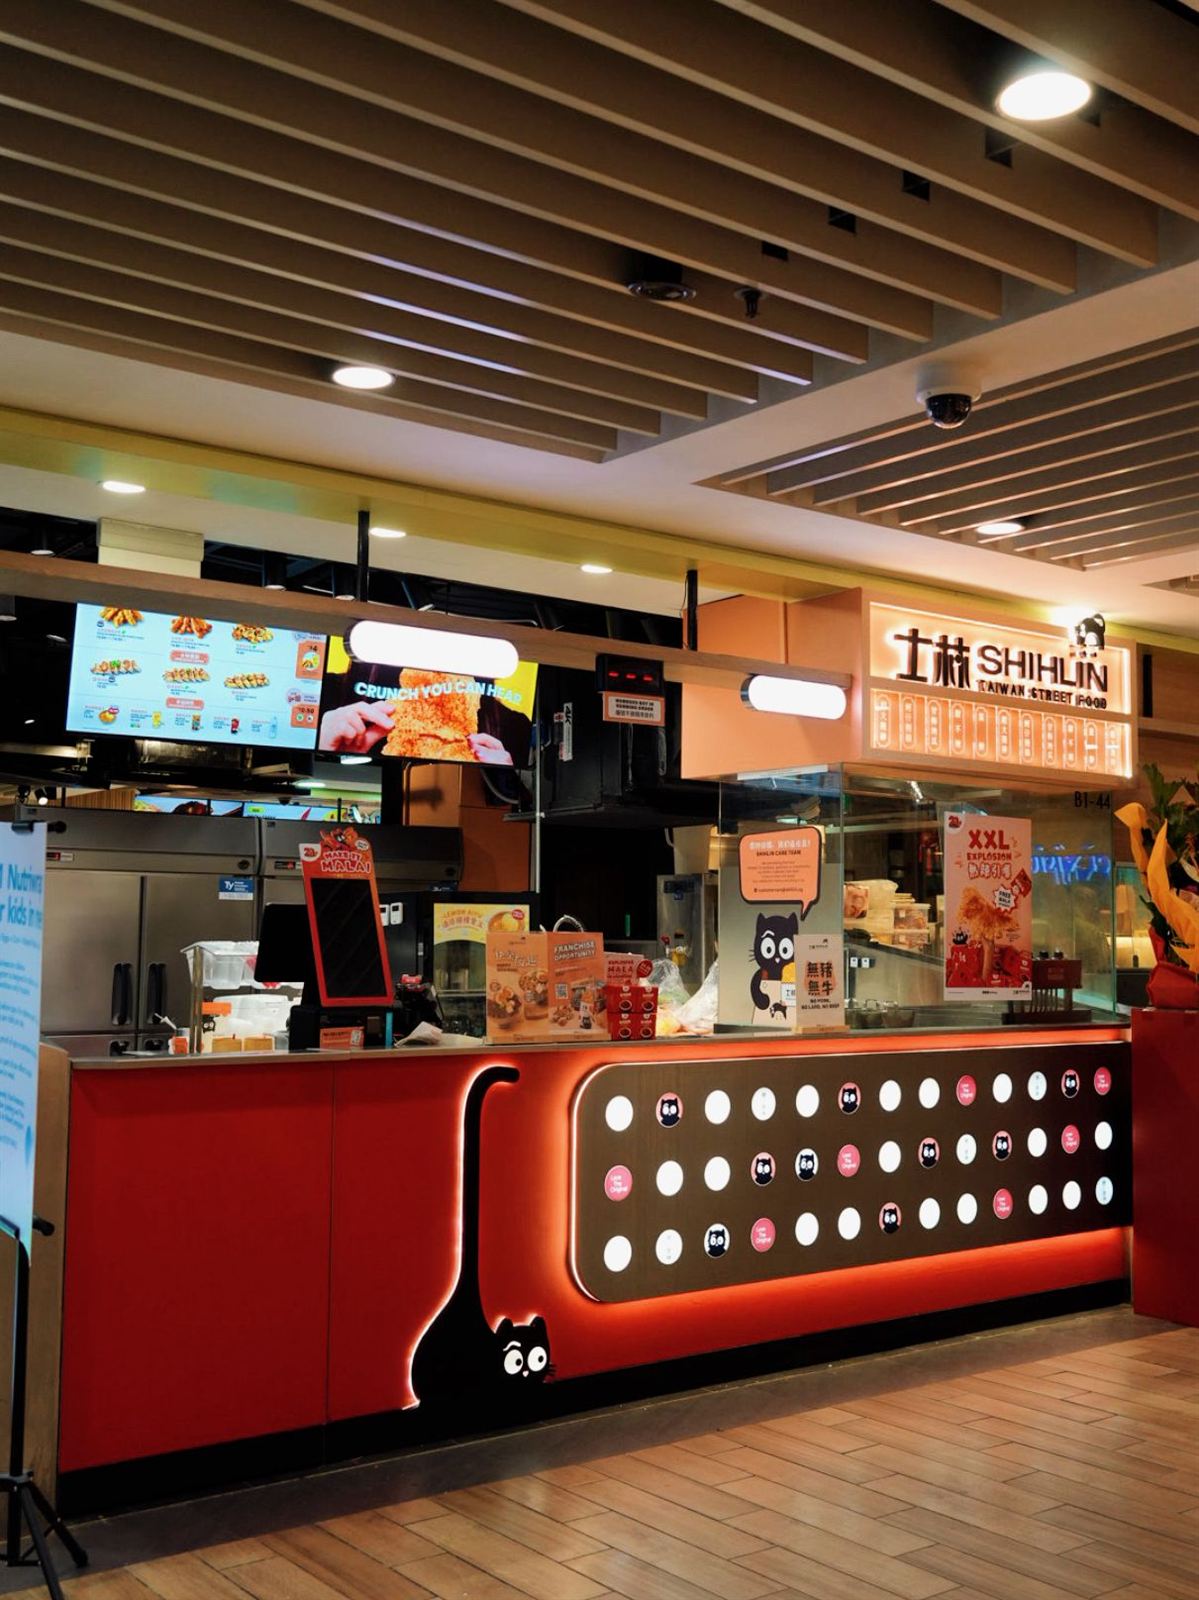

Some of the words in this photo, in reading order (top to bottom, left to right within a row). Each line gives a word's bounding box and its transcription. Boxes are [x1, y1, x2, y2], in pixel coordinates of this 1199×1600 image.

[894, 628, 970, 688] 士林
[977, 644, 1108, 693] SHIHLIN
[354, 682, 418, 700] CRUNCH
[421, 682, 452, 699] YOU
[455, 681, 485, 695] CAN
[487, 684, 521, 703] HEAR
[978, 680, 1025, 696] TAIWAN
[1029, 689, 1072, 705] STREET
[1076, 695, 1106, 709] FOOD
[1074, 791, 1110, 809] B1-44
[968, 829, 1010, 850] XXL
[967, 852, 1012, 861] EXPLOSION
[554, 940, 595, 953] FRANCHISE
[554, 949, 595, 961] OPPORTUNITY
[807, 961, 833, 978] 無豬
[807, 980, 833, 996] 無牛
